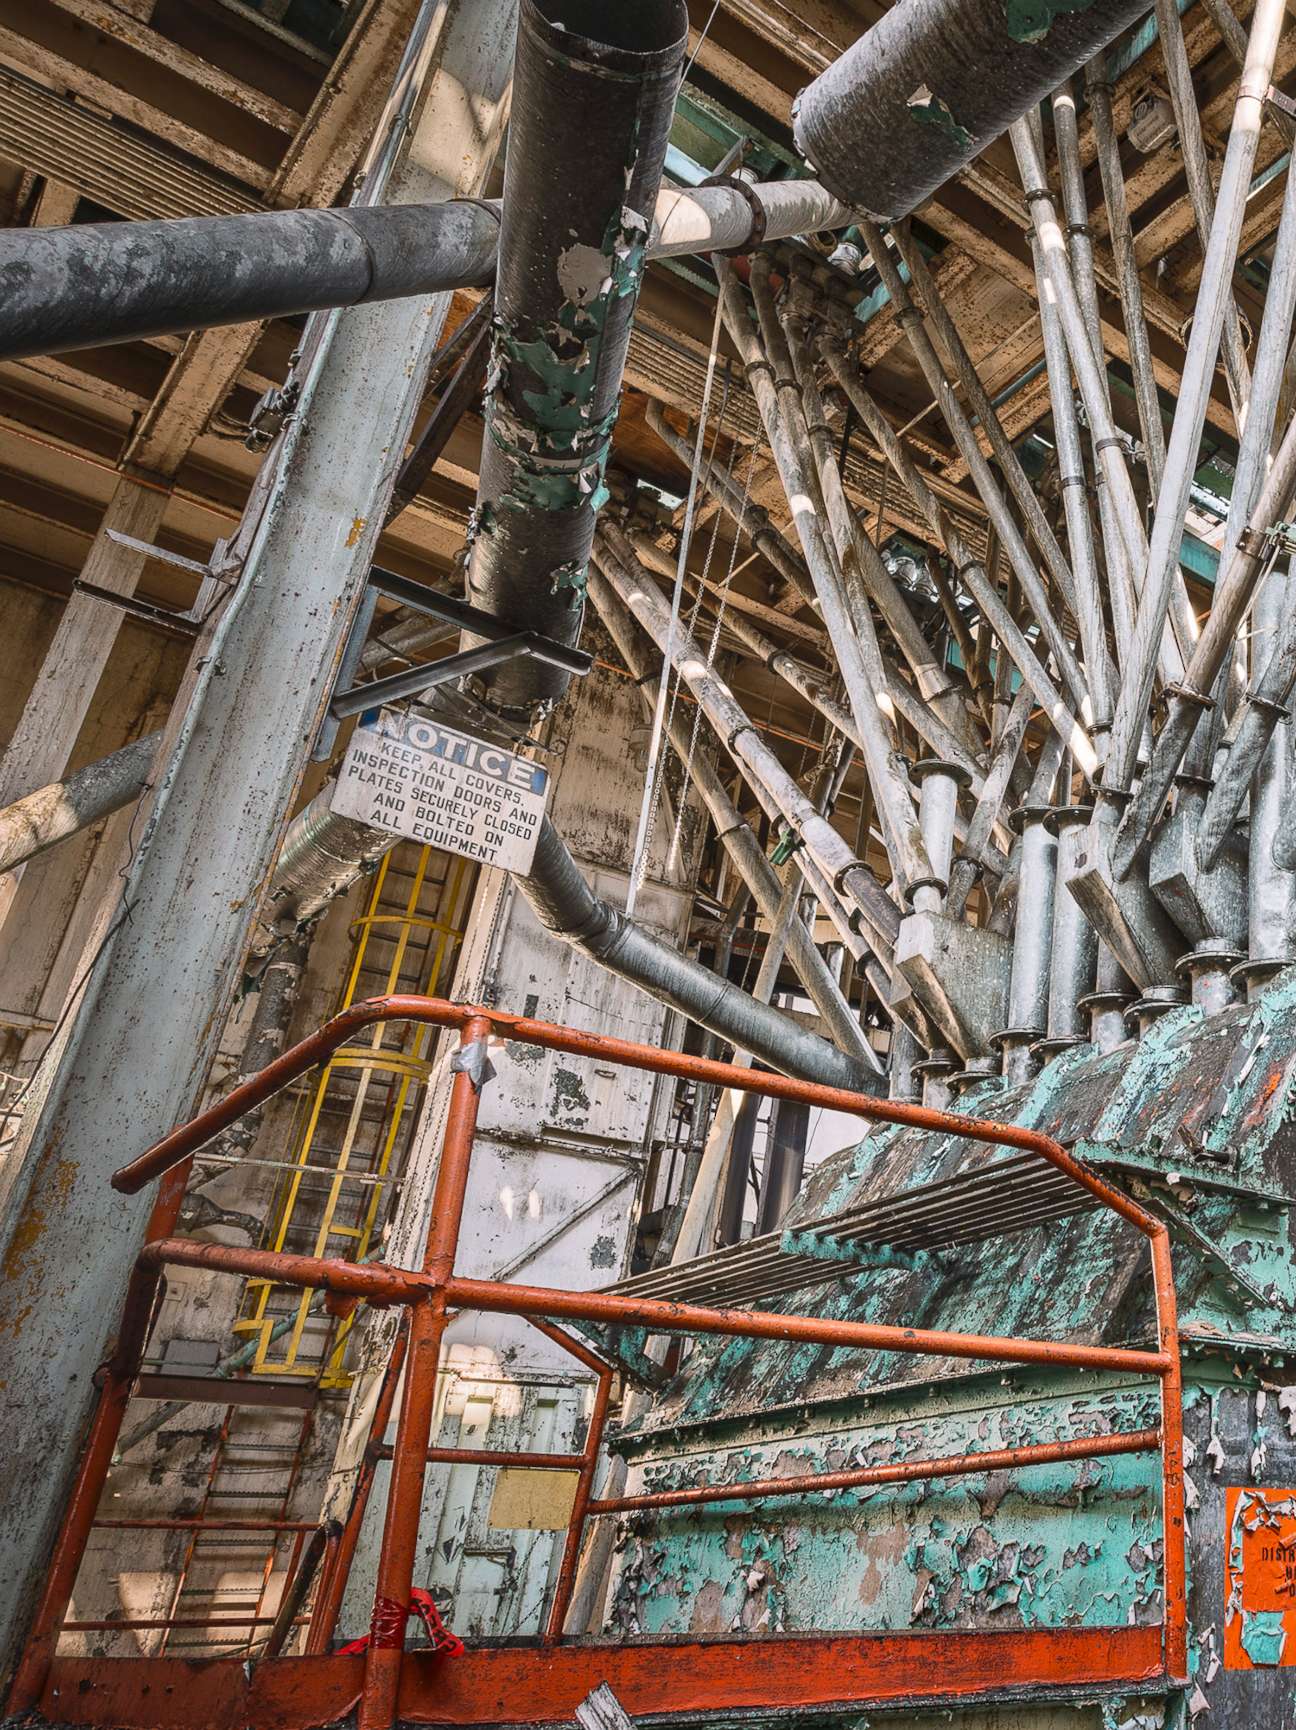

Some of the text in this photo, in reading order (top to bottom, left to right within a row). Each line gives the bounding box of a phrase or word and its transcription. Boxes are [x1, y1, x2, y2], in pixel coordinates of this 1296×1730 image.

[381, 710, 535, 790] NOTICE
[428, 762, 457, 780] ALL
[348, 765, 531, 841] PLATES SECURELY CLOSED
[352, 749, 537, 826] INSPECTION DOORS AND
[373, 792, 503, 847] AND BOLTED ON
[370, 810, 497, 863] ALL EQUIPMENT
